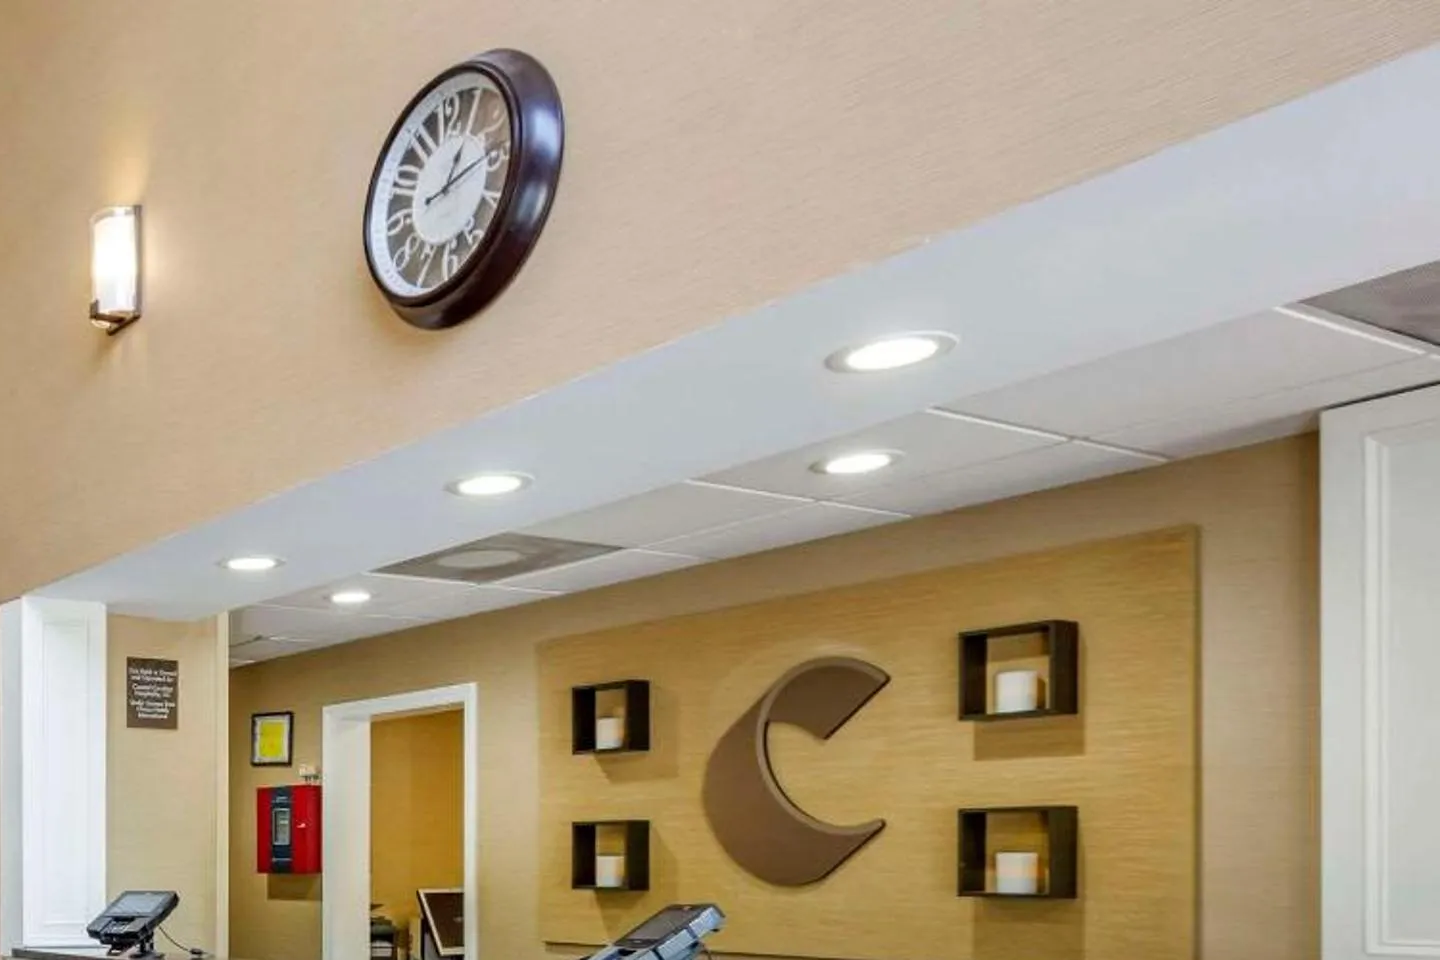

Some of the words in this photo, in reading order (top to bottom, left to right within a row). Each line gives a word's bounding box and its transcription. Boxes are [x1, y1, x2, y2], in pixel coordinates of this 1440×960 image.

[433, 94, 462, 142] 12
[465, 87, 481, 136] 1
[409, 124, 437, 162] 11
[393, 164, 421, 196] 10
[386, 207, 418, 236] 9
[393, 231, 421, 271] 8
[416, 242, 438, 287] 7
[441, 239, 459, 281] 6
